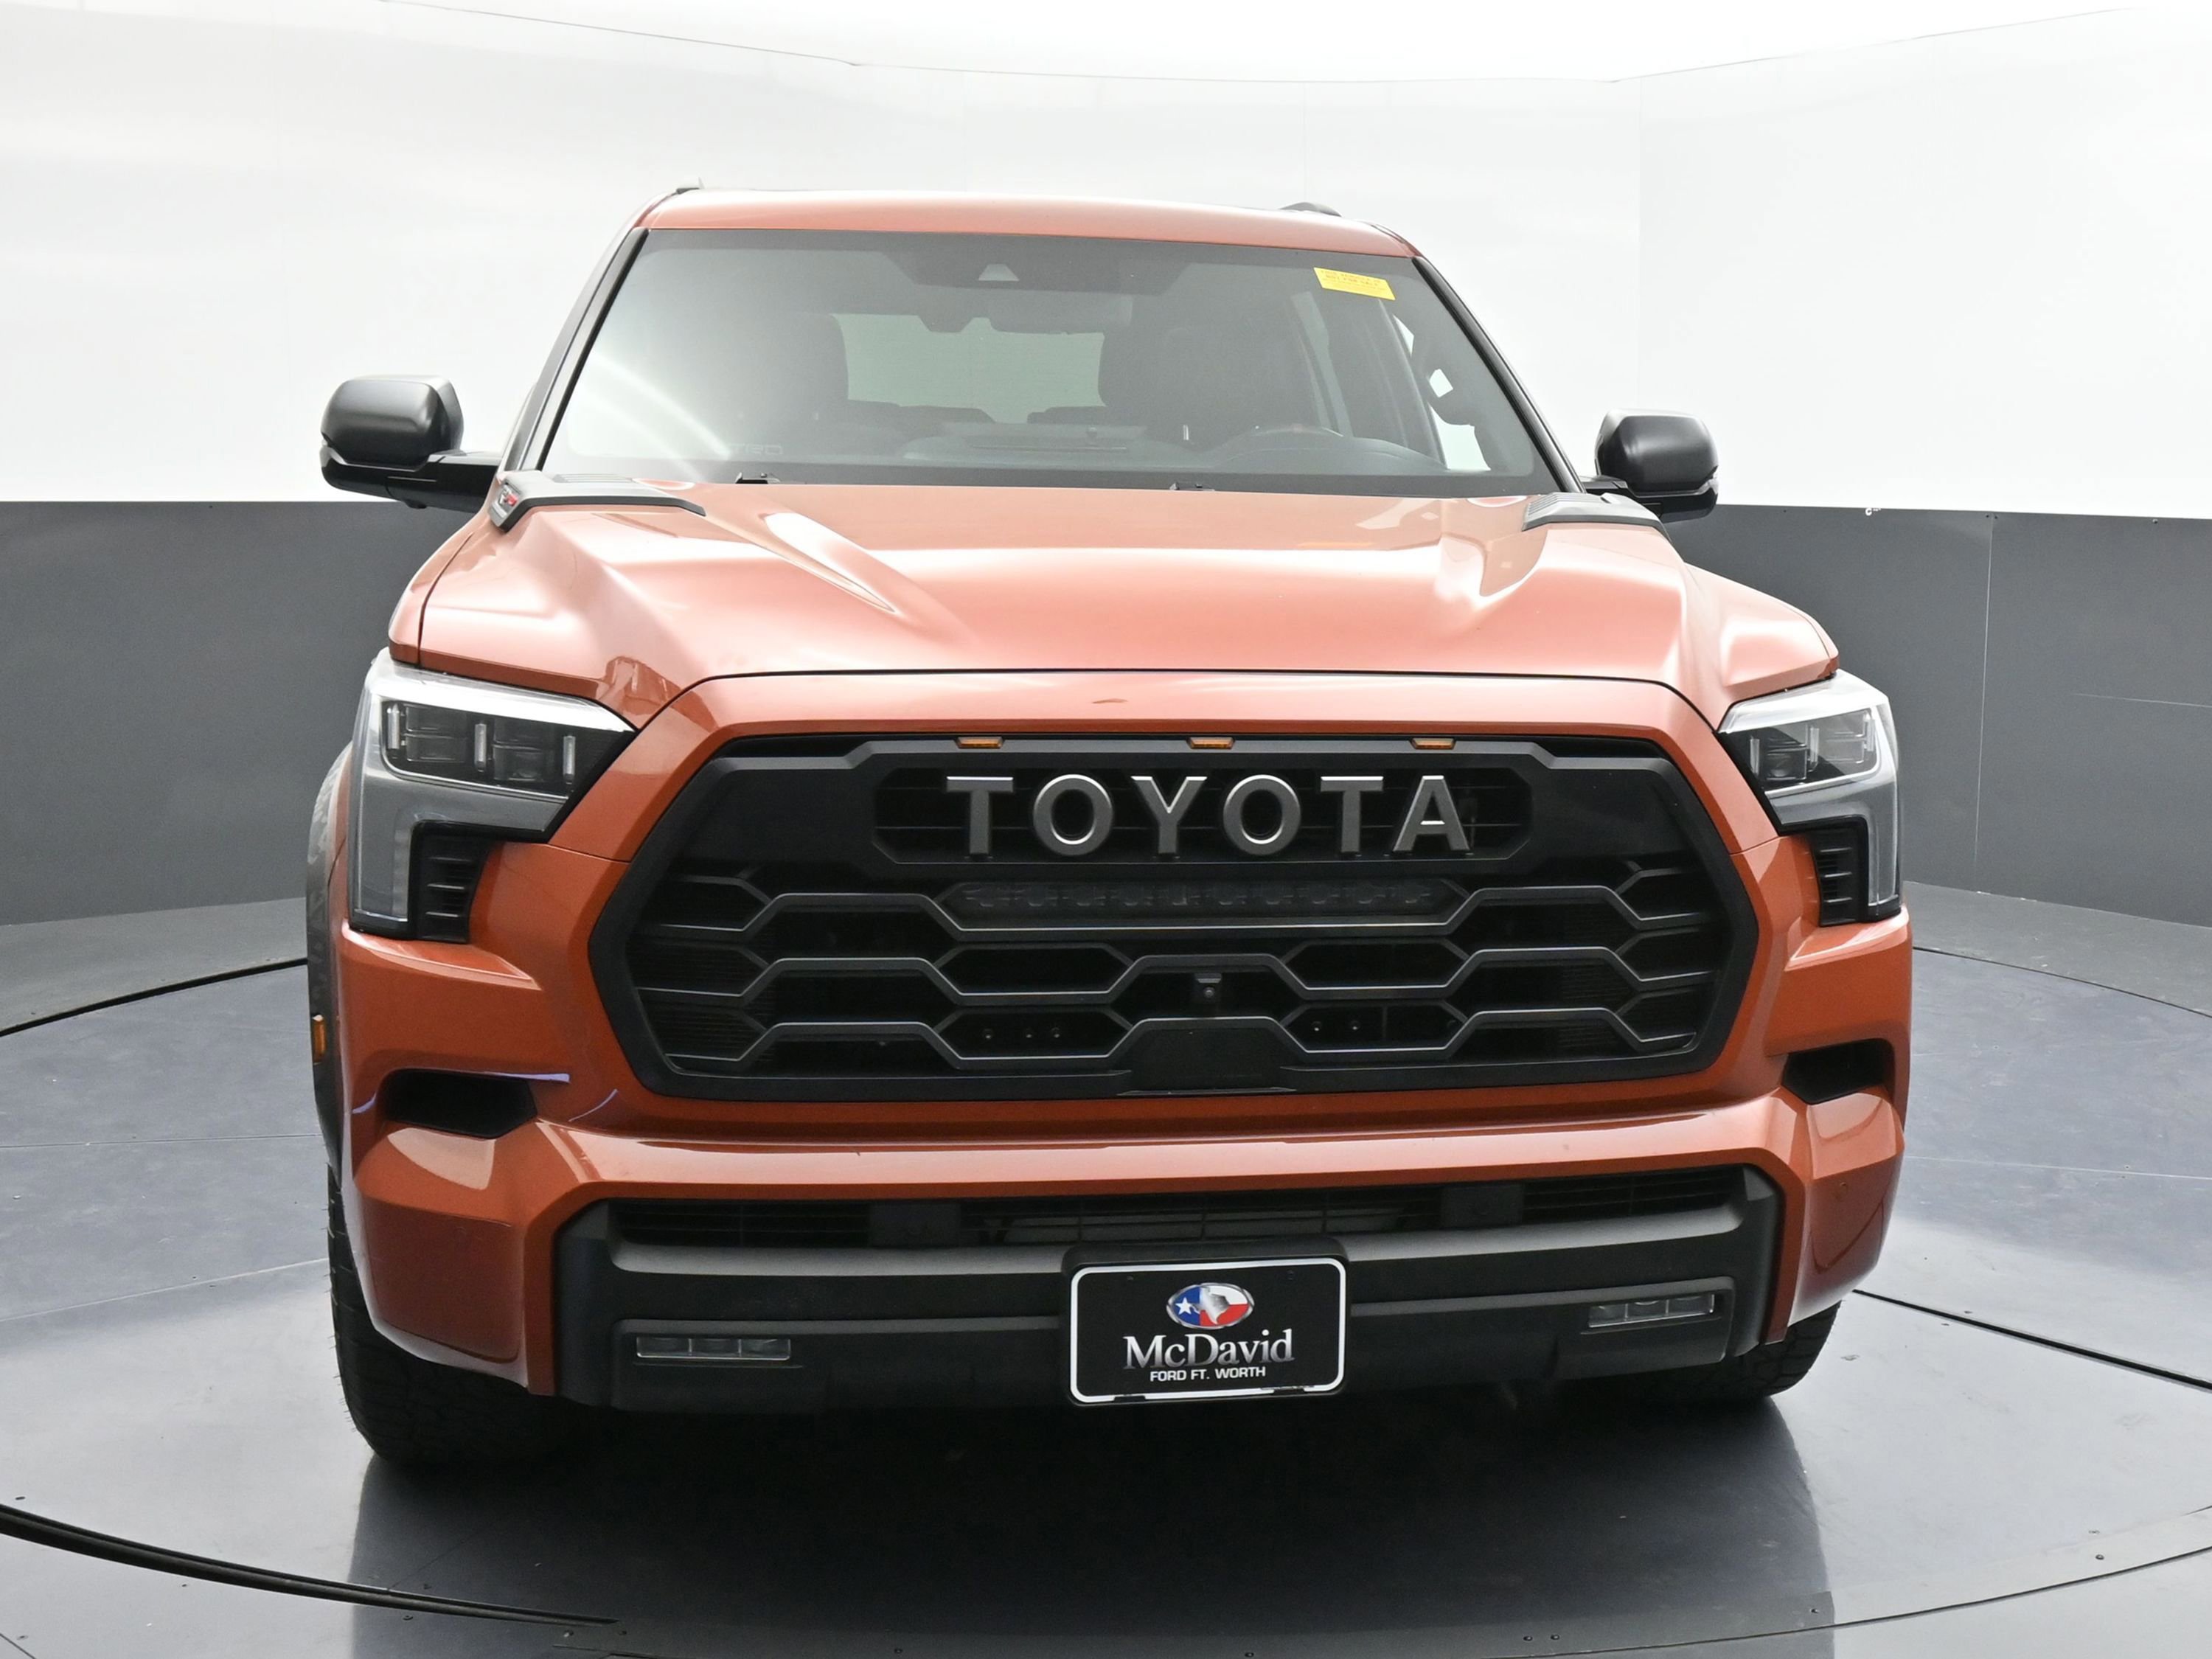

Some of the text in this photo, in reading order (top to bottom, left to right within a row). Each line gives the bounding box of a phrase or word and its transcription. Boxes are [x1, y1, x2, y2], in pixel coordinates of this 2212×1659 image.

[947, 773, 1471, 856] TOYOTA
[1123, 1329, 1295, 1369] McDavid
[1150, 1366, 1266, 1382] FORD FT. WORTH
